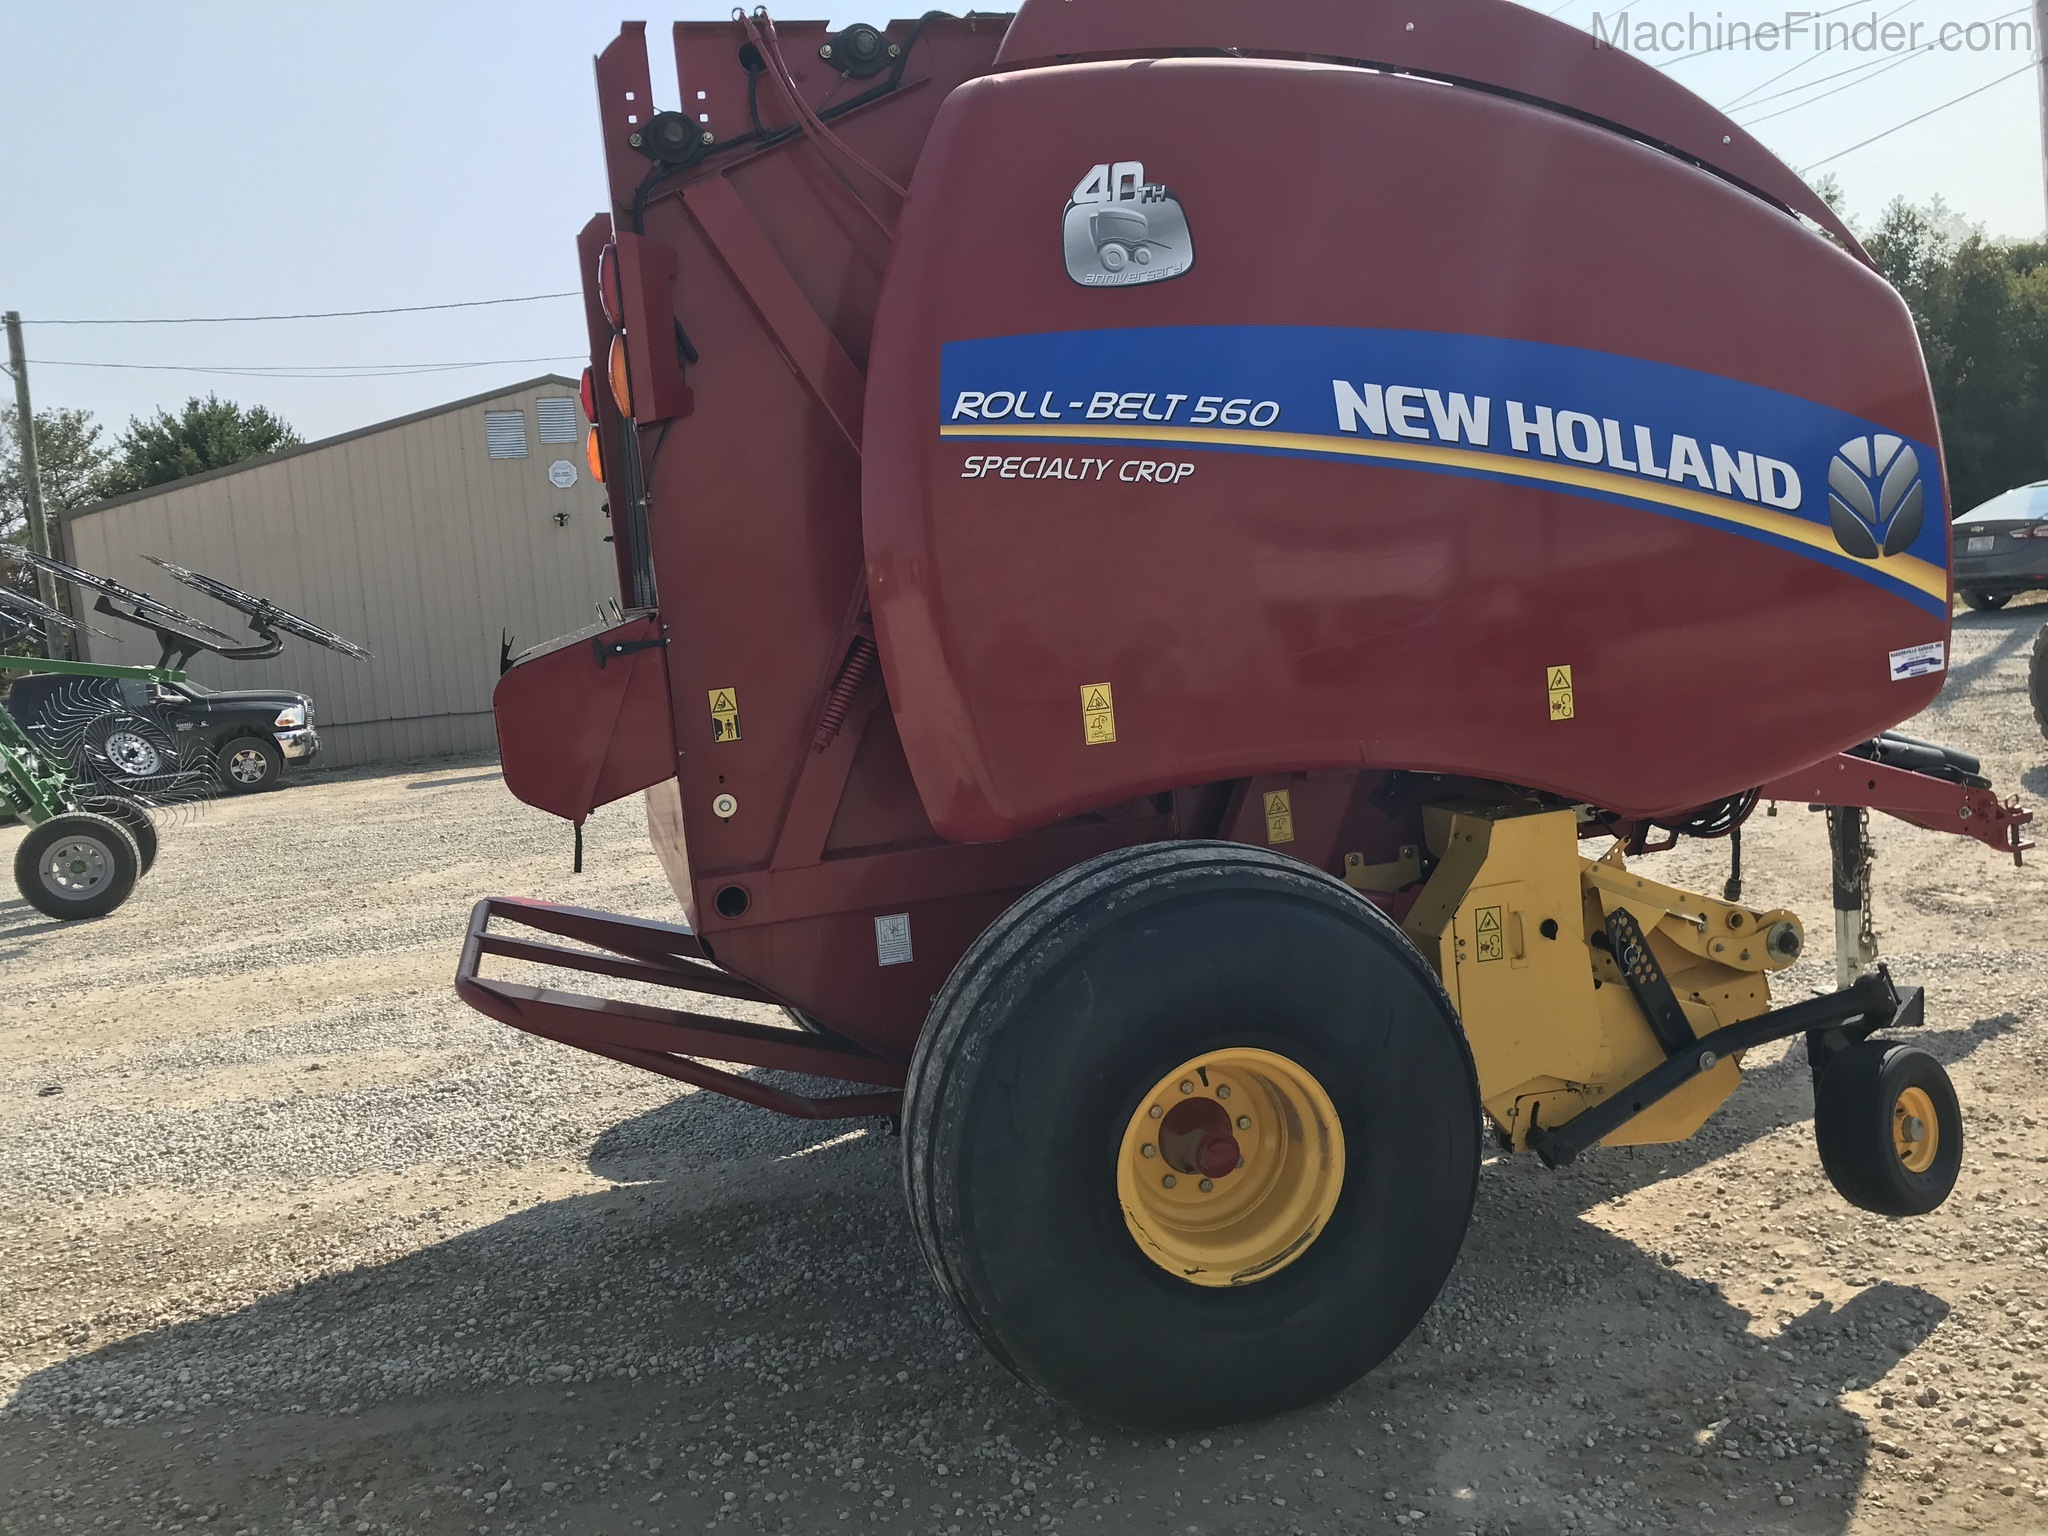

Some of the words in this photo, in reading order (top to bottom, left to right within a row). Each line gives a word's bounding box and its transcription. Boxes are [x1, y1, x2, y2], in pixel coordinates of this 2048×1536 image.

[1084, 262, 1183, 284] anniversary
[1189, 396, 1280, 427] 560
[1332, 379, 1491, 446] NEW
[1506, 400, 1802, 511] HOLLAND
[961, 456, 1114, 481] SPECIALTY
[1118, 459, 1195, 484] CROP
